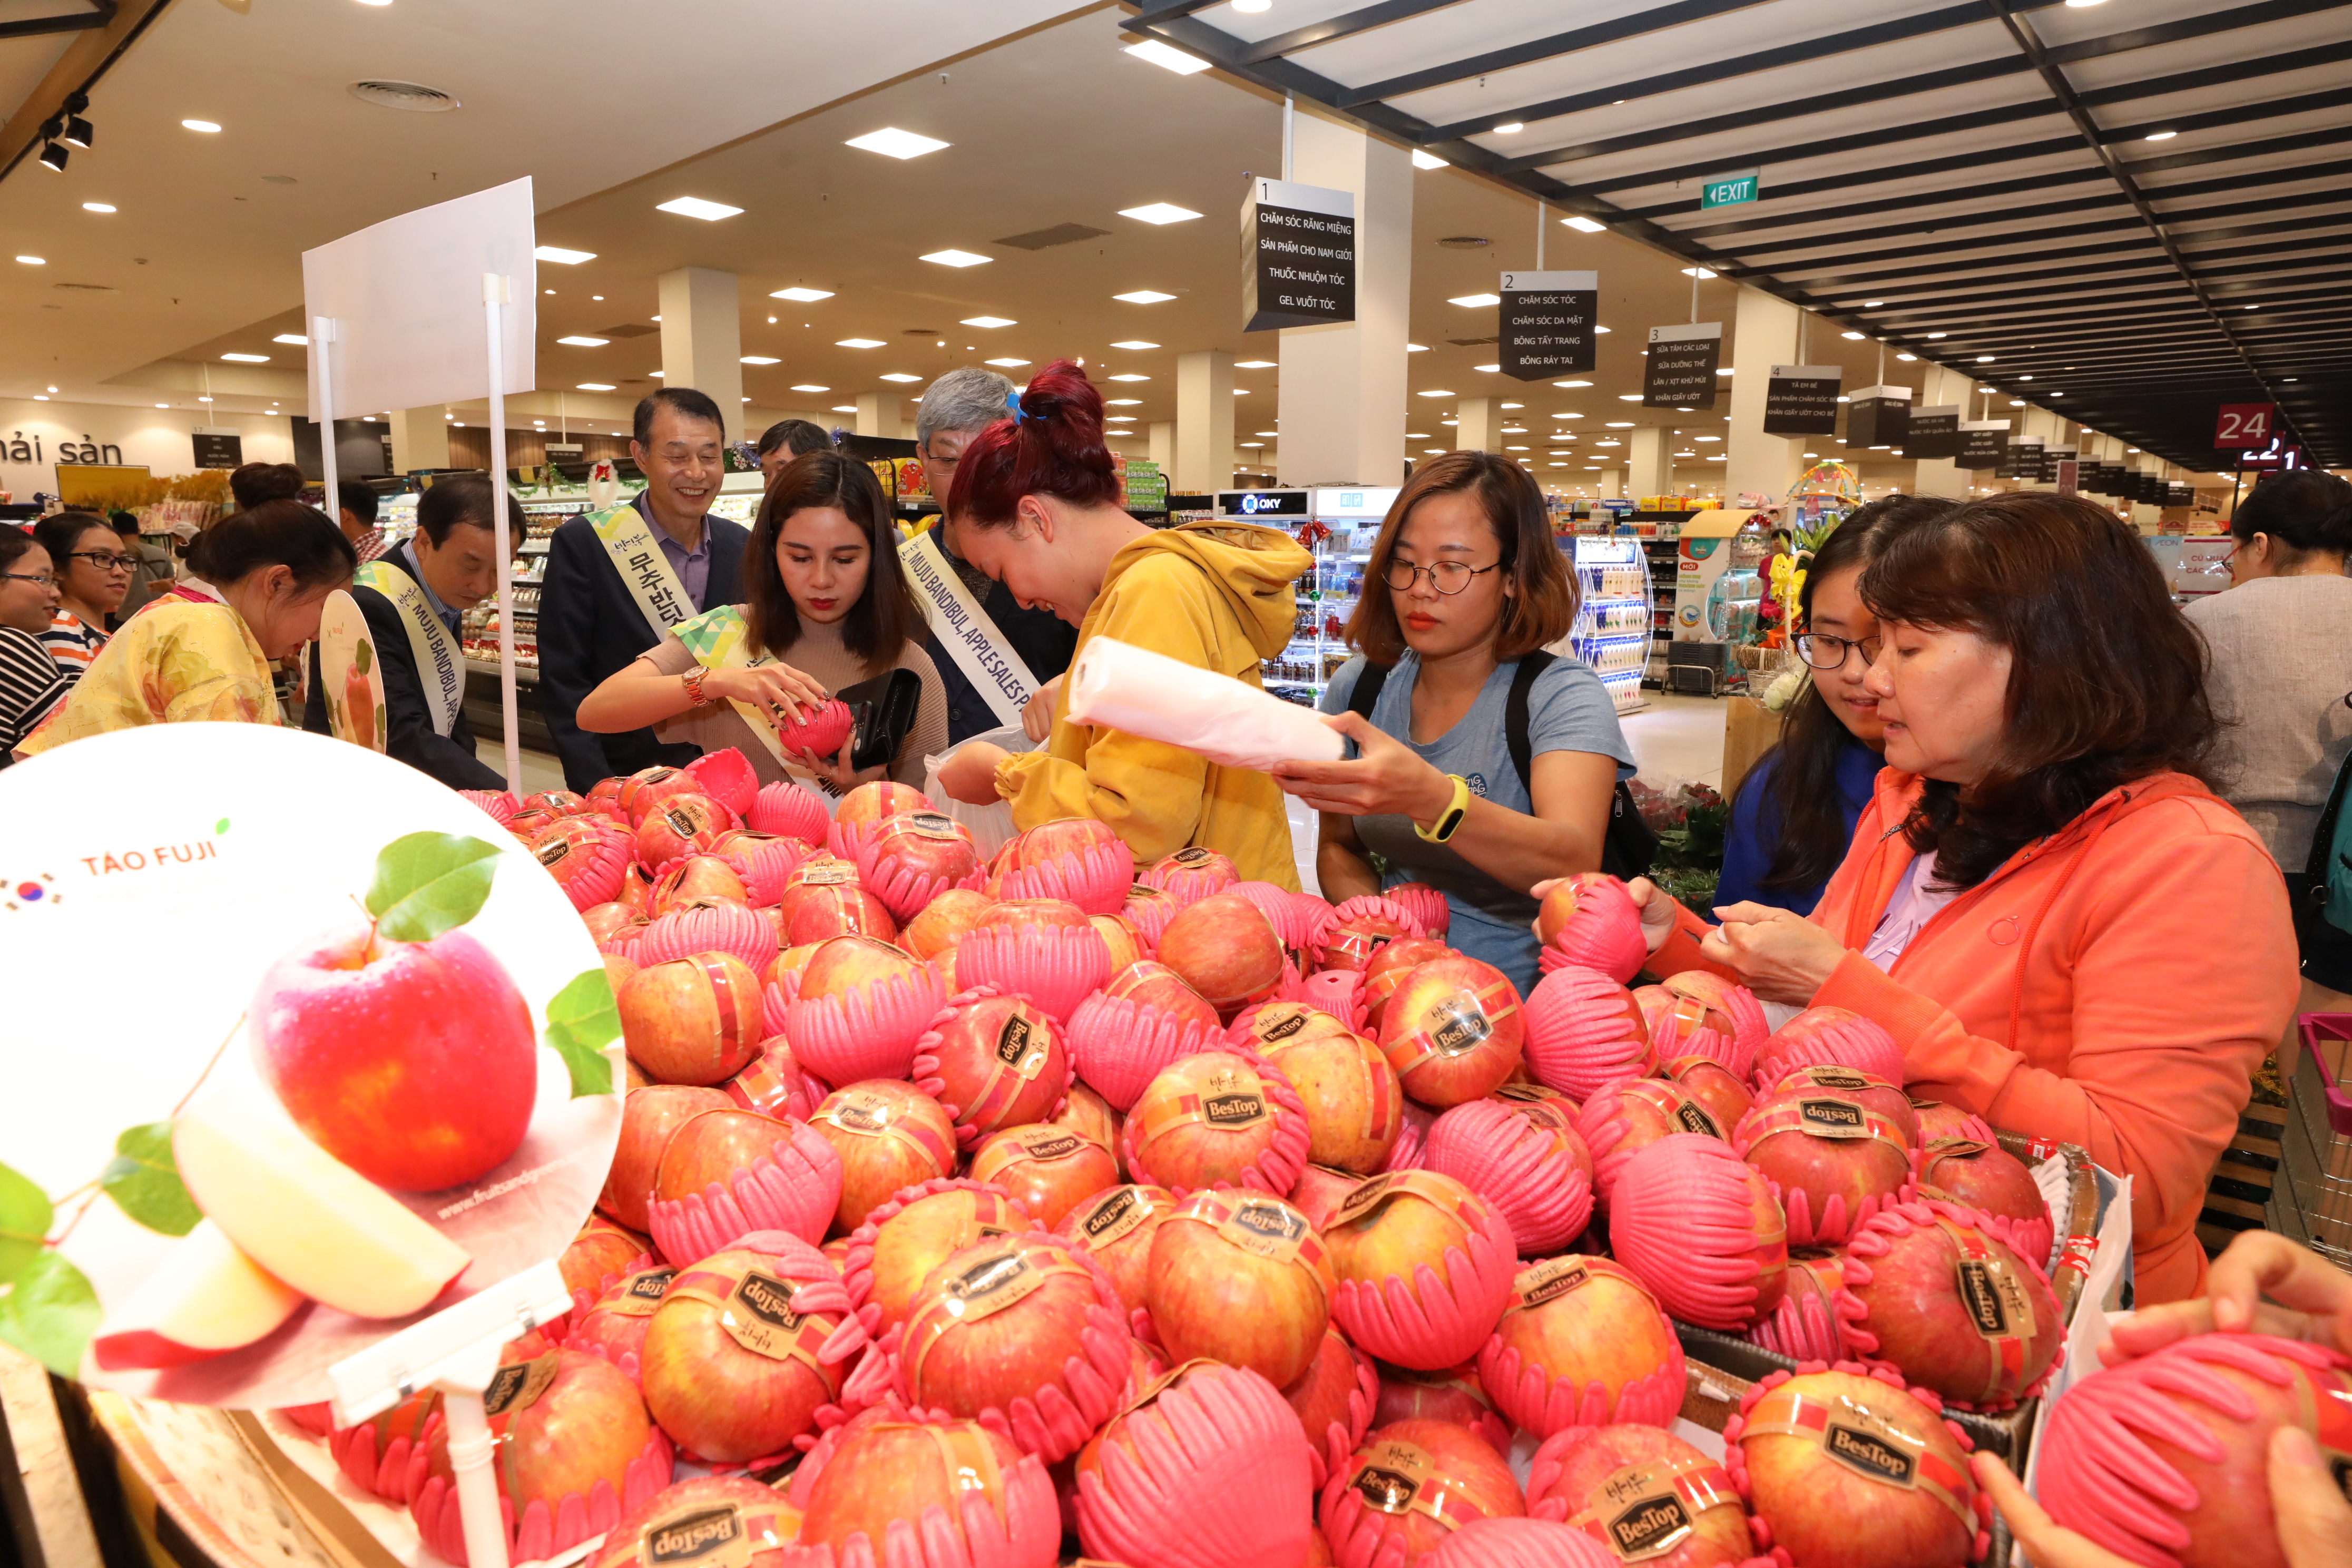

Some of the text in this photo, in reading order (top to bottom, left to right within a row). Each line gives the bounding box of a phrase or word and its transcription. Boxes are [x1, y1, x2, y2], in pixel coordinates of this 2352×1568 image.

[1262, 182, 1267, 201] 1
[1718, 181, 1750, 203] EXIT
[1260, 212, 1351, 235] CHĂM SÓC RĂNG MIỆNG
[1261, 237, 1276, 250] SẢN
[1300, 244, 1316, 256] CHO
[1318, 248, 1334, 258] NAM
[1336, 248, 1352, 260] GIỚI
[1299, 270, 1327, 284] NHUỘM
[1329, 272, 1345, 285] TÓC
[1505, 275, 1513, 288] 2
[1279, 295, 1295, 306] GEL
[1319, 298, 1335, 310] TÓC
[1518, 295, 1576, 304] CHĂM SÓC TÓC
[1512, 316, 1534, 325] CHĂM
[1536, 315, 1552, 325] SÓC
[1567, 315, 1583, 326] MẶT
[1514, 336, 1535, 345] BÔNG
[1652, 329, 1659, 340] 3
[1520, 355, 1541, 365] BÔNG
[1543, 355, 1559, 364] RÁY
[1773, 367, 1780, 376] 4
[2219, 412, 2266, 439] 24
[59, 434, 122, 465] sản
[1259, 498, 1281, 509] OXY
[412, 603, 439, 640] MUJU
[908, 551, 935, 583] MUJU
[924, 575, 969, 635] BANDIBUL,
[962, 628, 998, 667] APPLE
[987, 660, 1025, 701] SALES
[673, 812, 692, 835] BesTop
[915, 818, 950, 830] BesTop
[153, 840, 217, 866] FUJI
[539, 845, 566, 863] BesTop
[1178, 849, 1206, 862] BesTop
[1266, 1017, 1301, 1040] BesTop
[1438, 1019, 1482, 1046] BesTop
[1002, 1022, 1028, 1061] BesTop
[1819, 1076, 1862, 1087] BesTop
[1208, 1099, 1258, 1115] BesTop
[1807, 1105, 1858, 1124] BesTop
[1031, 1139, 1075, 1155] BesTop
[1091, 1193, 1134, 1232] BesTop
[745, 1282, 797, 1328] BesTop
[1969, 1270, 1998, 1329] BesTop
[1835, 1429, 1907, 1475] BesTop
[1616, 1504, 1680, 1545] BesTop
[654, 1518, 733, 1555] BesTop
